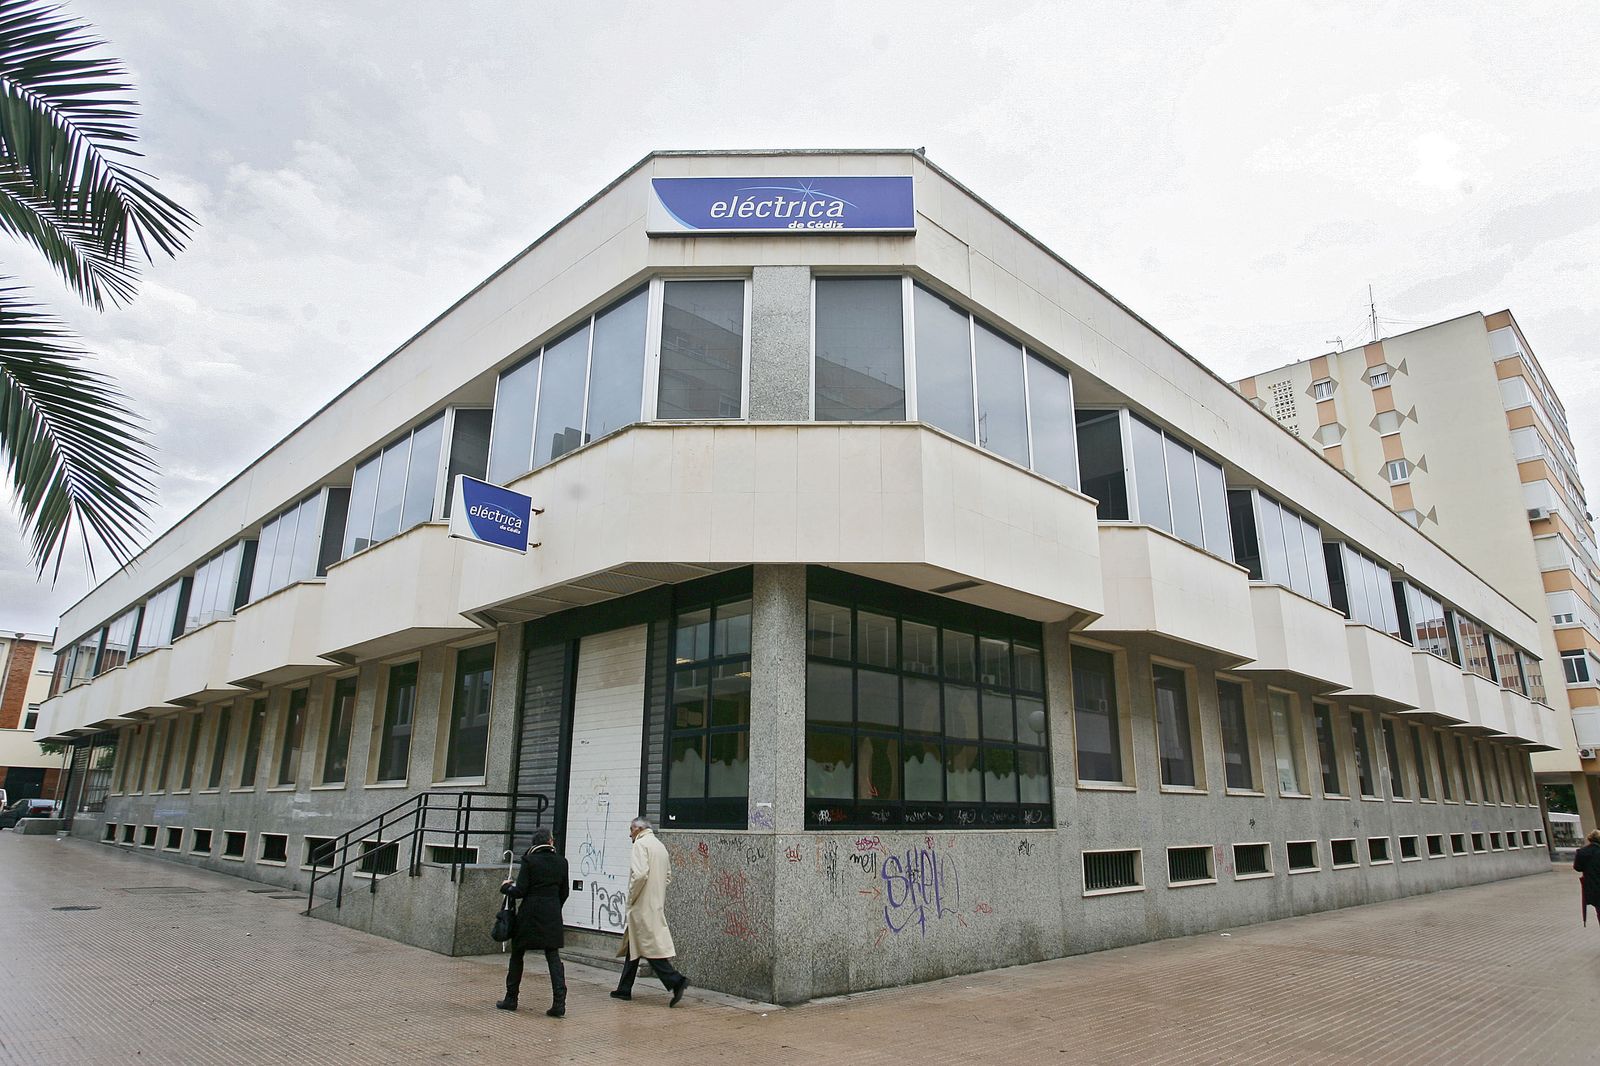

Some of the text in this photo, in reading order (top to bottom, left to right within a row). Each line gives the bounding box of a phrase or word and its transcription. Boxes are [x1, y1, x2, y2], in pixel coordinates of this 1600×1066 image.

[710, 195, 844, 218] eléctrica
[788, 219, 844, 229] de Cádiz
[469, 504, 522, 529] eléctrica
